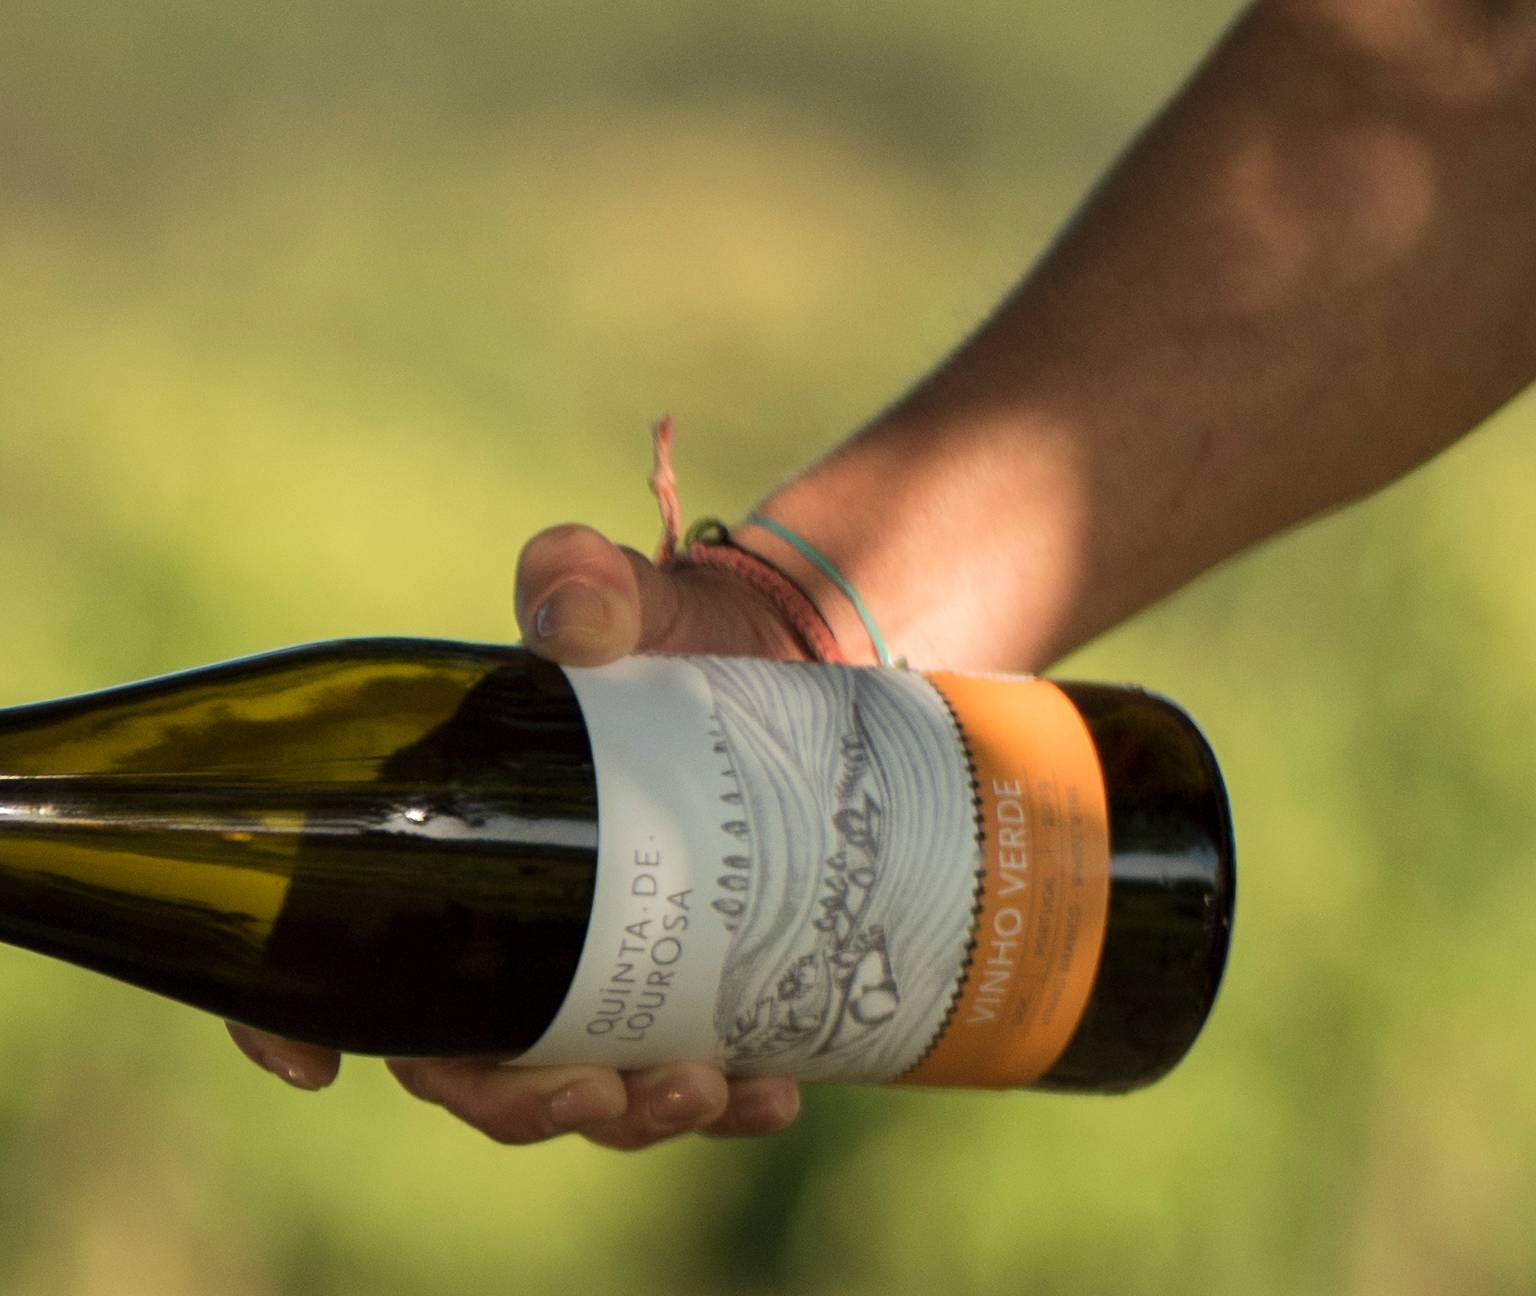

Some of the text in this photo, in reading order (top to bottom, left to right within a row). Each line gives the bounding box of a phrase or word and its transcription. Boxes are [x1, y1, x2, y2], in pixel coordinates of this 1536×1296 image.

[586, 849, 660, 1036] QUINTA DE
[616, 888, 693, 1042] LOUROSA
[967, 778, 1027, 1025] VINHO VERDE
